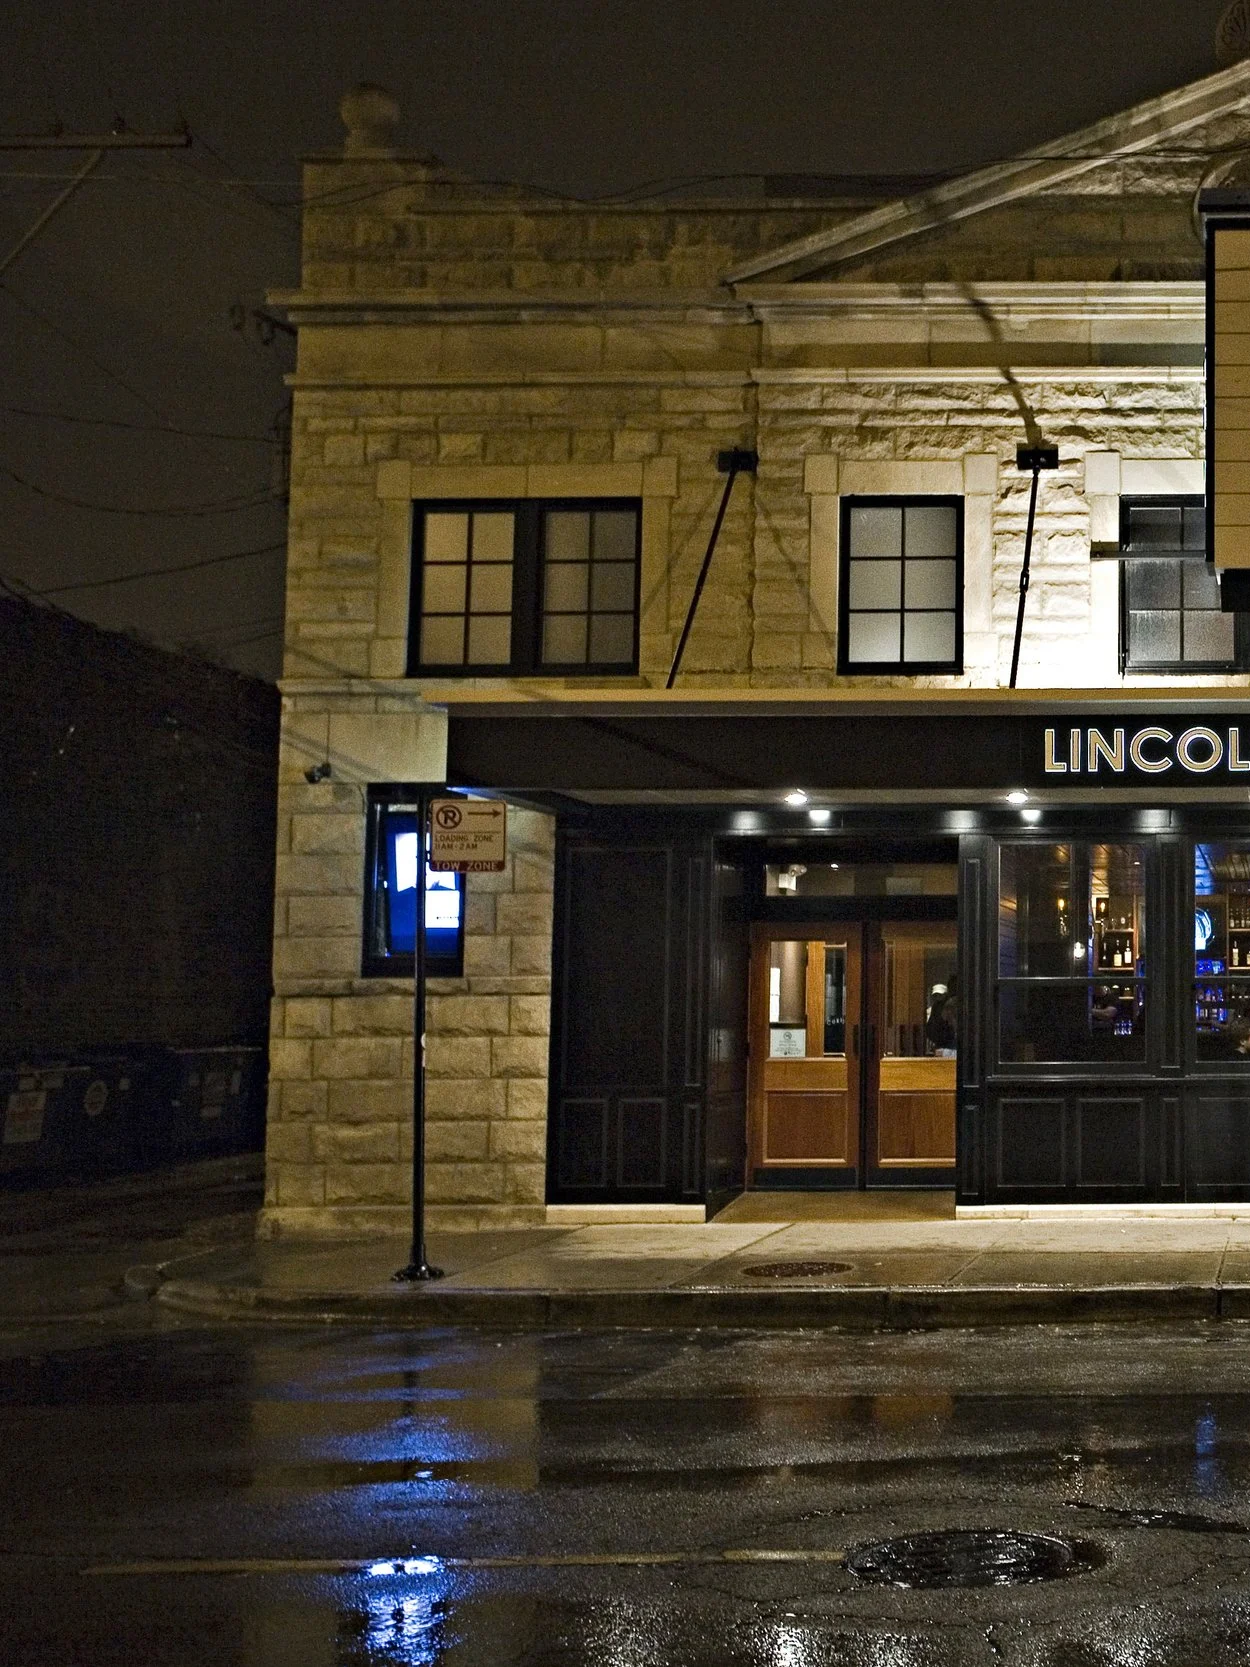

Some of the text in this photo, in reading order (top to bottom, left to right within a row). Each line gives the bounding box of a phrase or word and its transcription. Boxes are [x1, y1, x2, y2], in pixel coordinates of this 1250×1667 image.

[435, 834, 494, 842] LOADING ZONE
[436, 861, 498, 870] TOW ZONE
